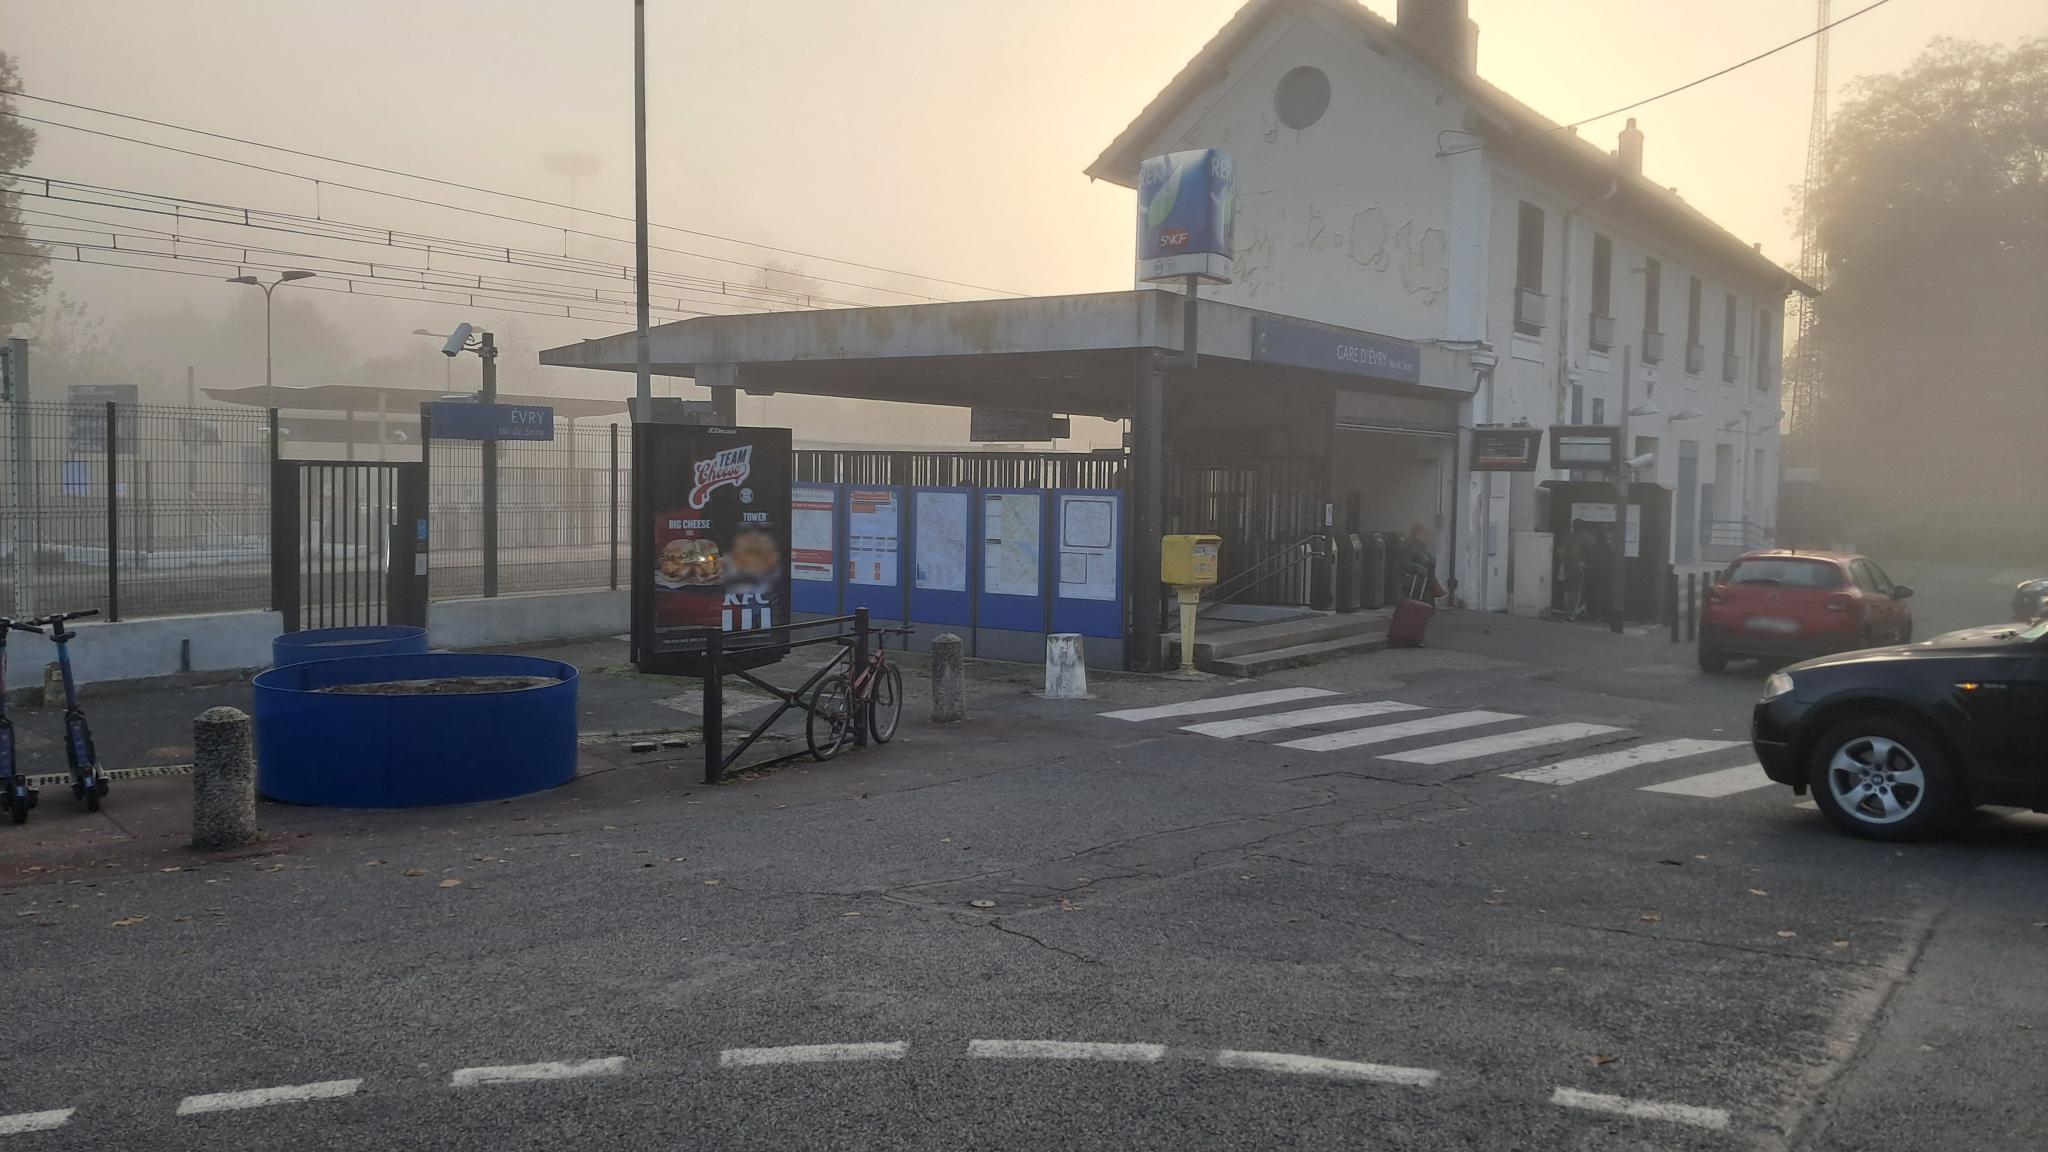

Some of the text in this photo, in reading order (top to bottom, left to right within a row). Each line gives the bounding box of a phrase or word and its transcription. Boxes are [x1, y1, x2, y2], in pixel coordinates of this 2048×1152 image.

[1160, 231, 1188, 247] SNCF
[1337, 345, 1358, 362] GARE
[512, 407, 545, 425] ÉVRY
[718, 449, 748, 467] TEAM
[697, 461, 745, 484] Cheese
[668, 519, 711, 529] BIG CHEESE
[743, 512, 768, 522] TOWER
